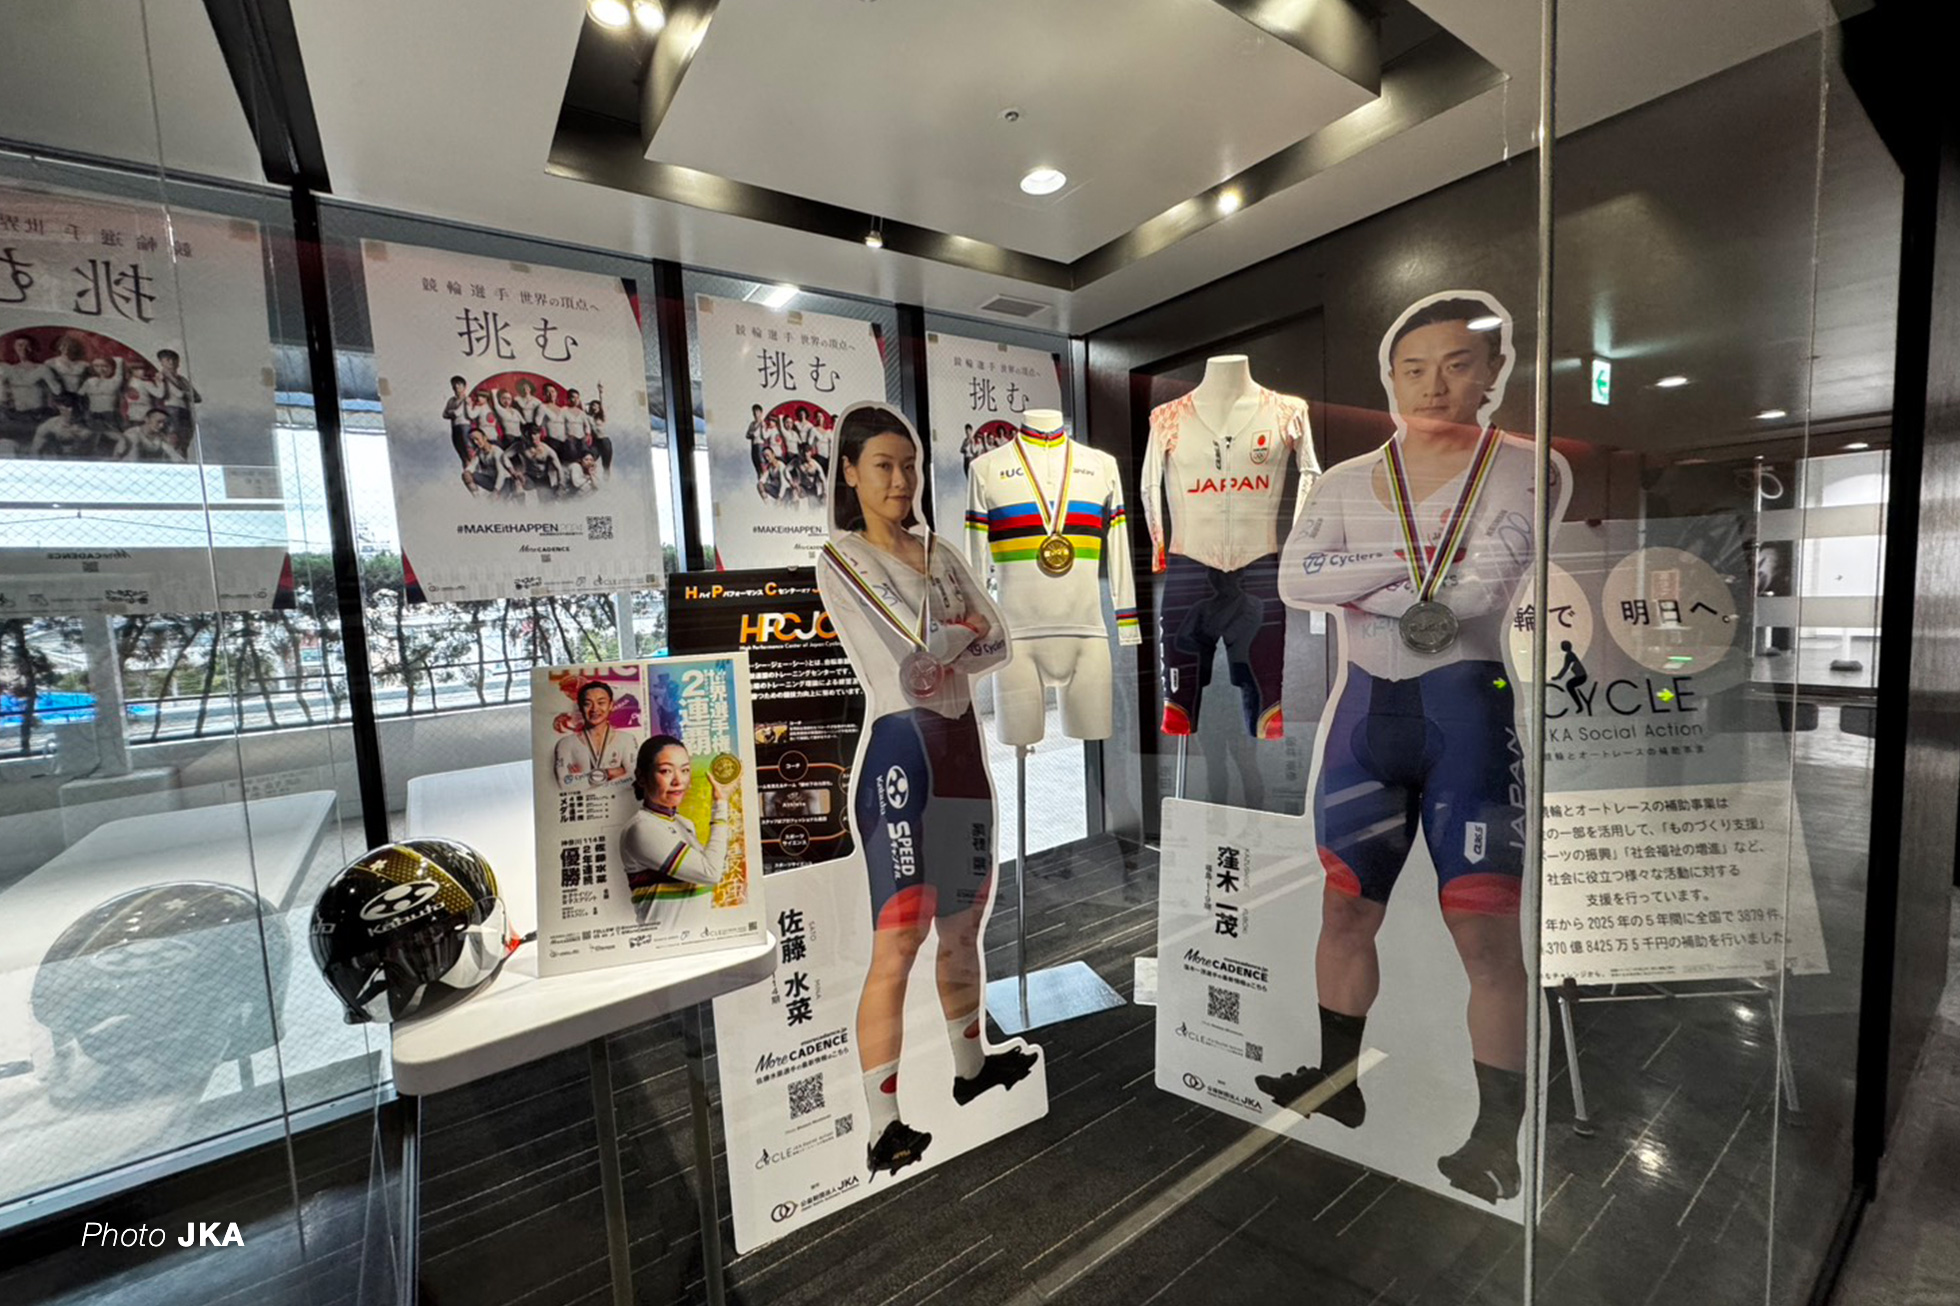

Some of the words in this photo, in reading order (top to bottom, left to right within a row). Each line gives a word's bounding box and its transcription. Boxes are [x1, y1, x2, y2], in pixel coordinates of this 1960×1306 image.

[422, 276, 509, 301] 競輪選手
[519, 289, 600, 312] 世界の頂点へ
[456, 307, 578, 362] 挑む
[757, 348, 841, 392] 挑む
[969, 376, 1030, 413] 挑む
[1187, 475, 1269, 493] JAPAN
[457, 522, 559, 535] #MAKEitHAPPEN
[1545, 676, 1698, 719] CYCLE
[1546, 728, 1573, 742] KA
[1579, 725, 1637, 742] Social
[1645, 722, 1704, 737] Action
[1544, 817, 1765, 841] の一部を活用して、「ものづくり支援」
[887, 821, 916, 876] SPEED
[1217, 846, 1240, 893] 窪木
[1547, 864, 1741, 887] 社会に役立つ様々な活動に対する
[1586, 888, 1710, 908] 支援を行っています。
[777, 908, 807, 964] 佐藤
[1215, 902, 1239, 939] 一茂
[784, 971, 813, 1027] 水菜
[1241, 1096, 1263, 1110] JKA
[837, 1175, 859, 1191] JKA
